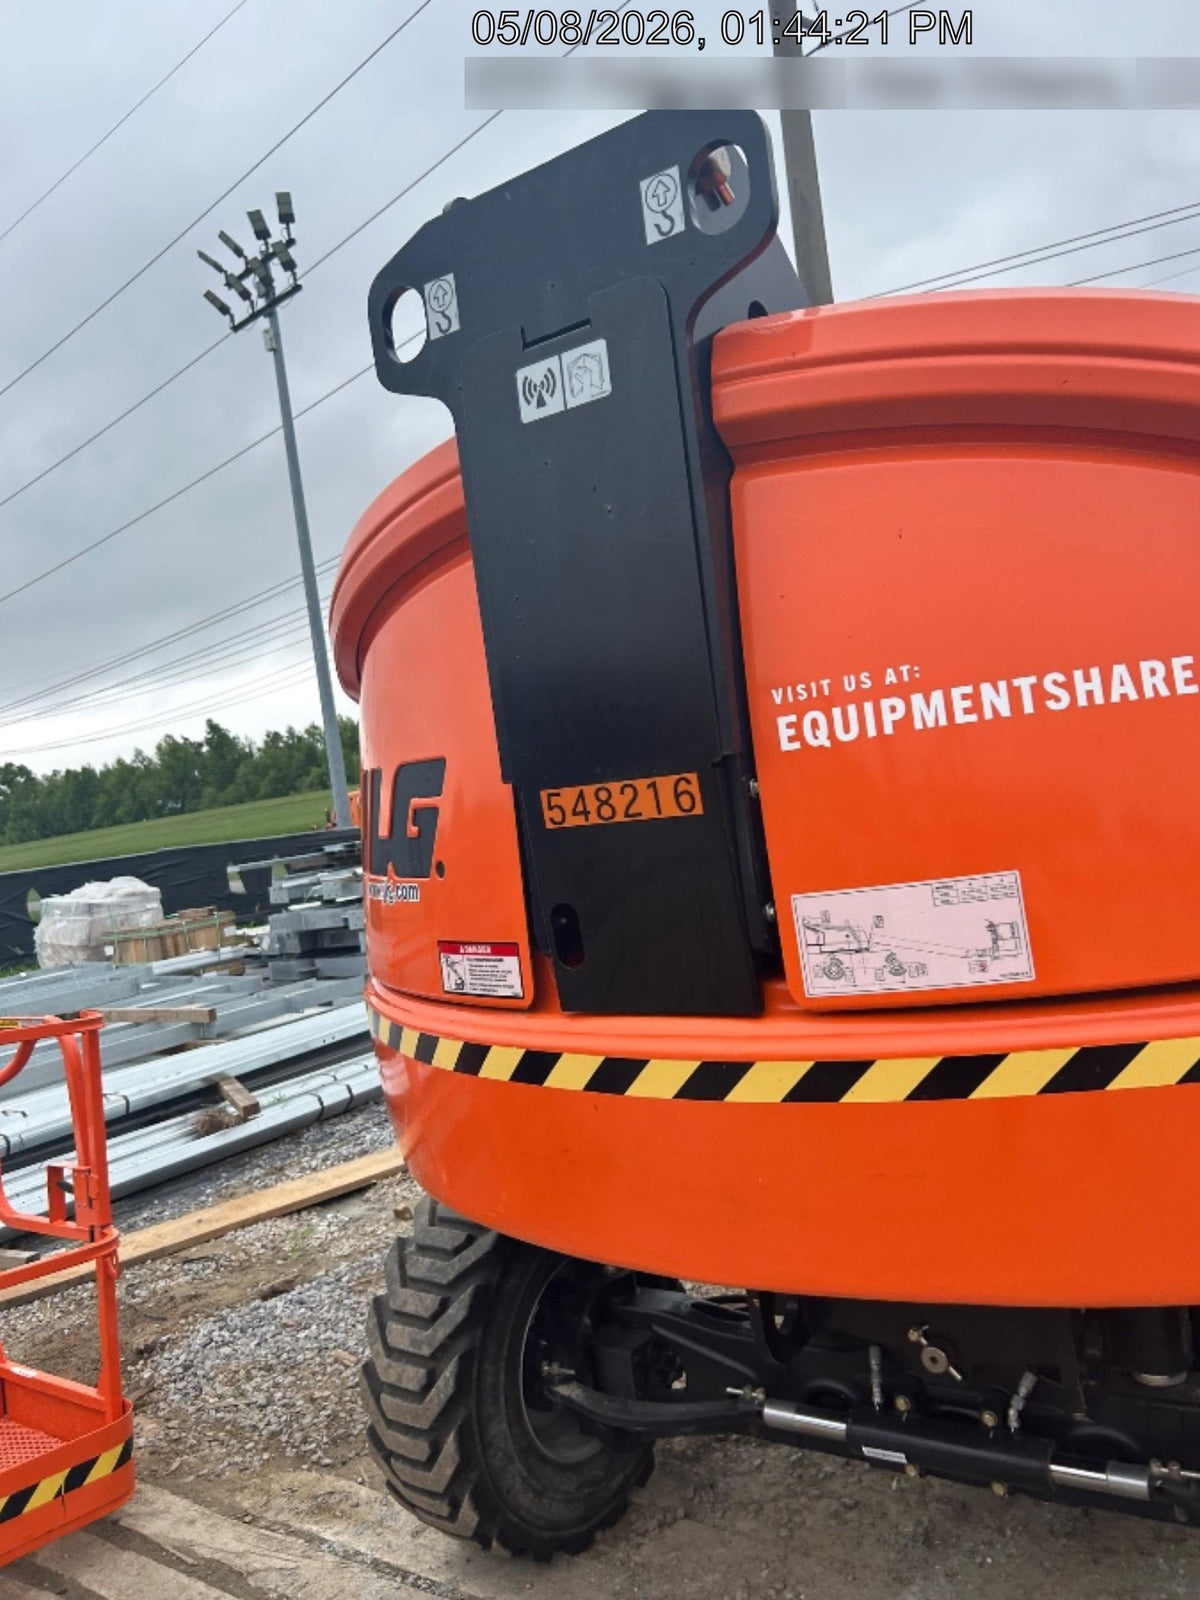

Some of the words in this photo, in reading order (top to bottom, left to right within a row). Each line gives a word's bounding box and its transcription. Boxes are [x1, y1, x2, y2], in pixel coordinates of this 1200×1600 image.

[771, 678, 832, 705] VISIT
[843, 671, 873, 693] US
[885, 664, 921, 686] AT:
[776, 655, 1199, 752] EQUIPMENTSHARE
[547, 776, 697, 826] 548216
